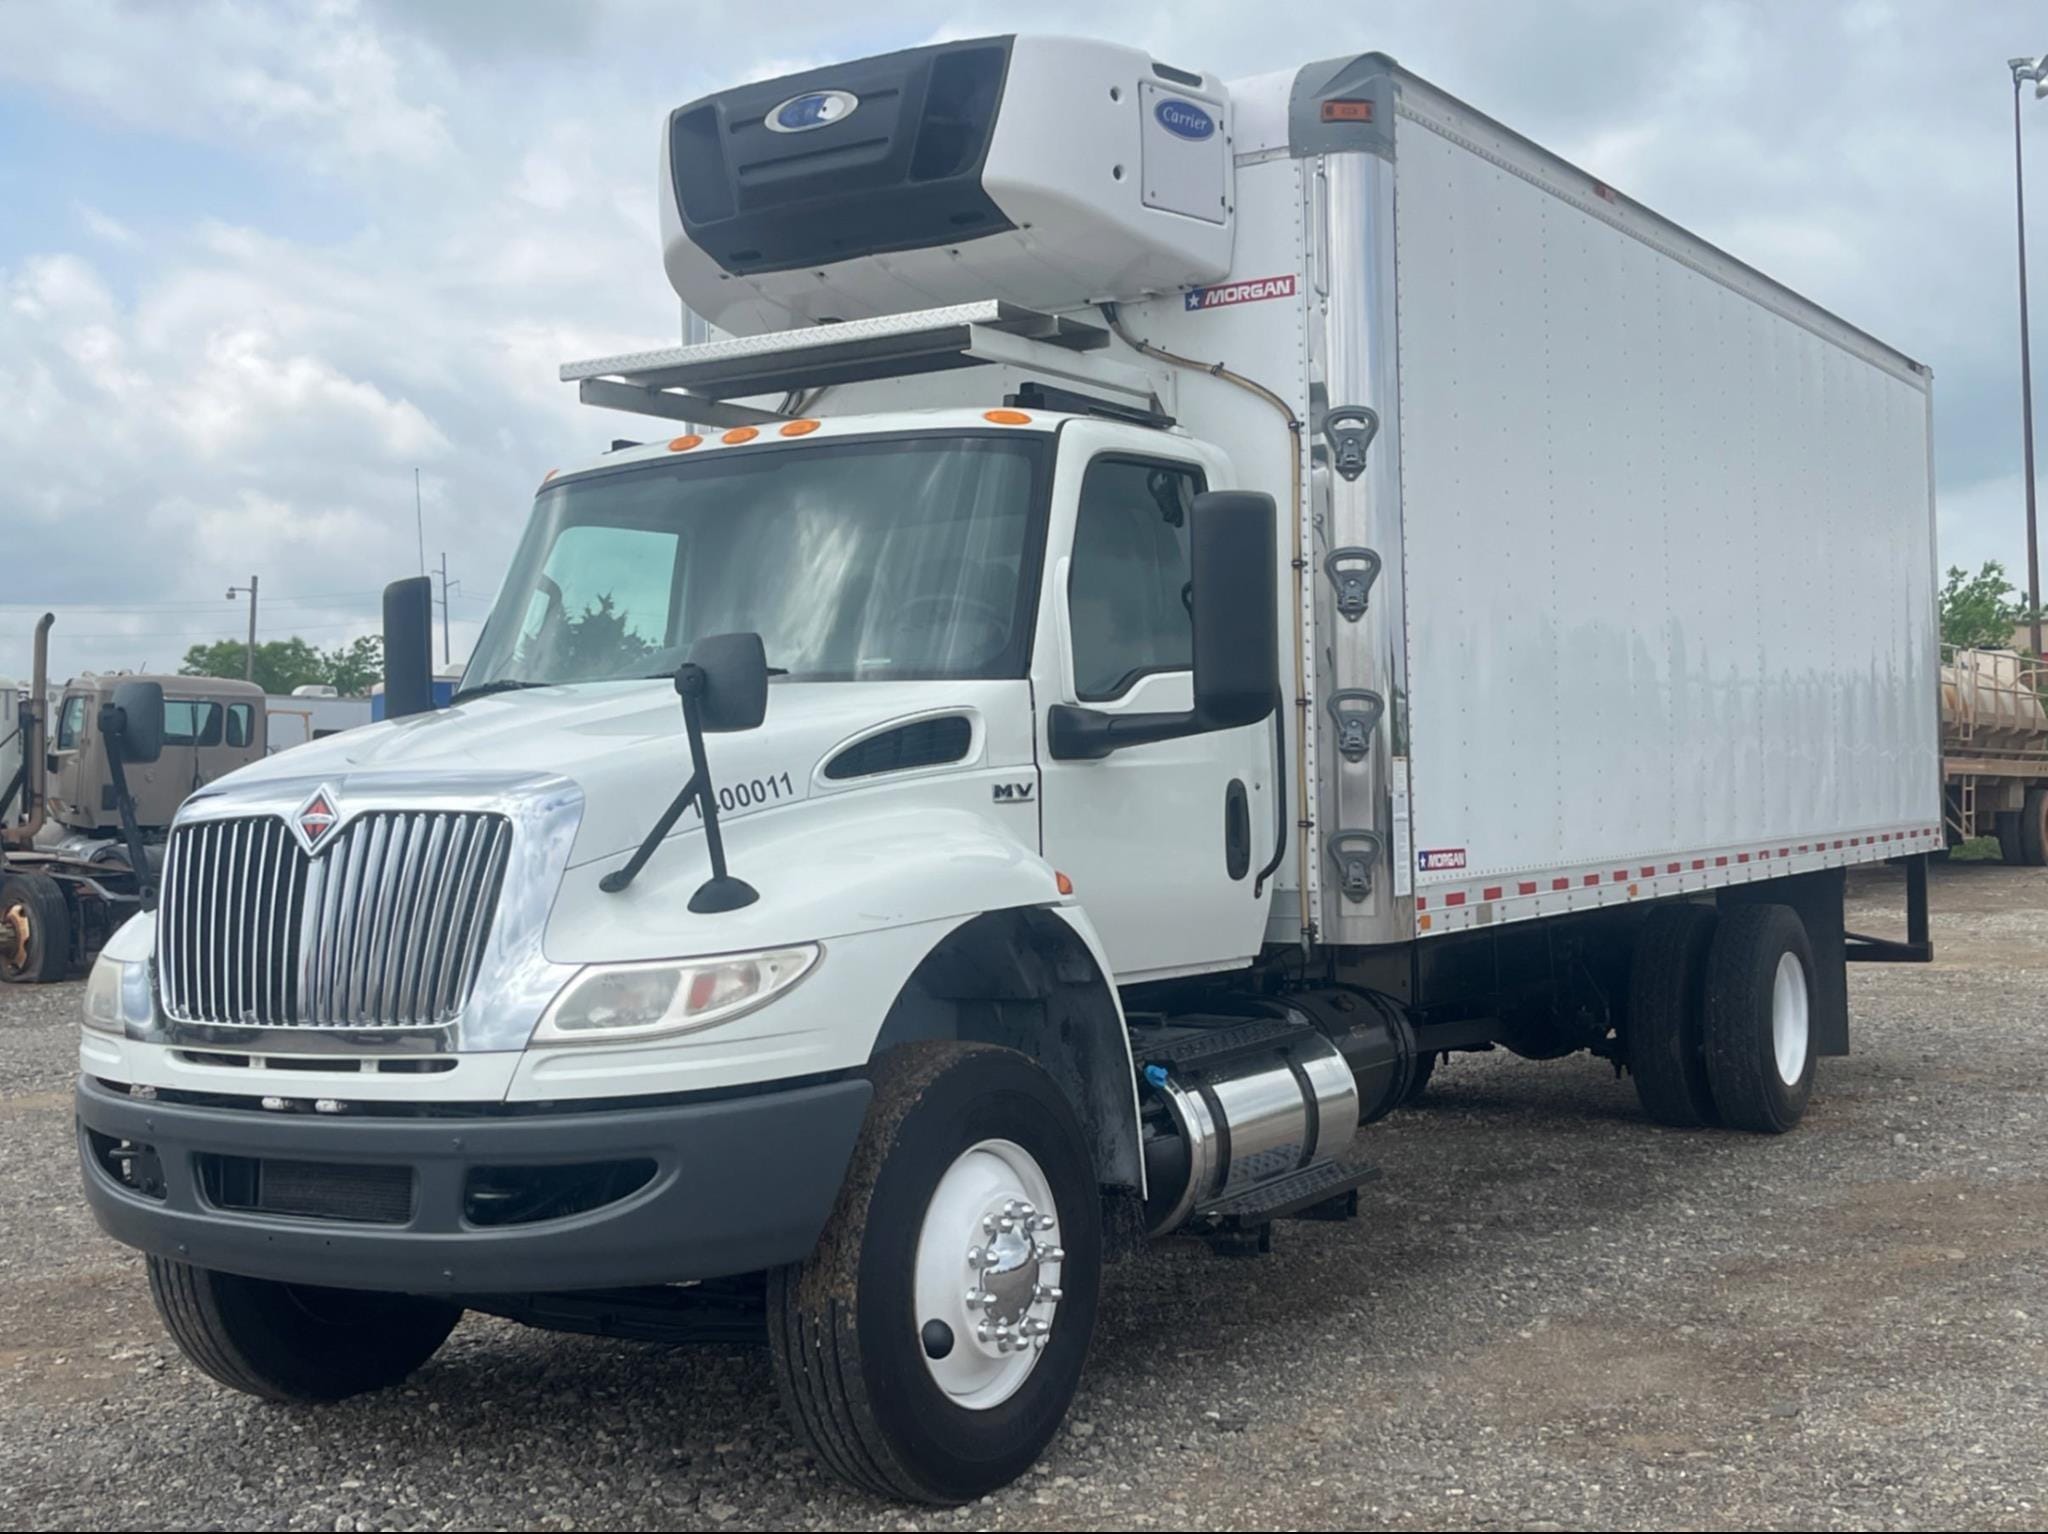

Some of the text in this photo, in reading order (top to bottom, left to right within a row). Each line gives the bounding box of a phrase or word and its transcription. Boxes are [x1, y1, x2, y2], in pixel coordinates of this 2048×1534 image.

[1162, 106, 1207, 130] Carrier
[1205, 279, 1291, 305] MORGAN
[994, 782, 1033, 798] MV
